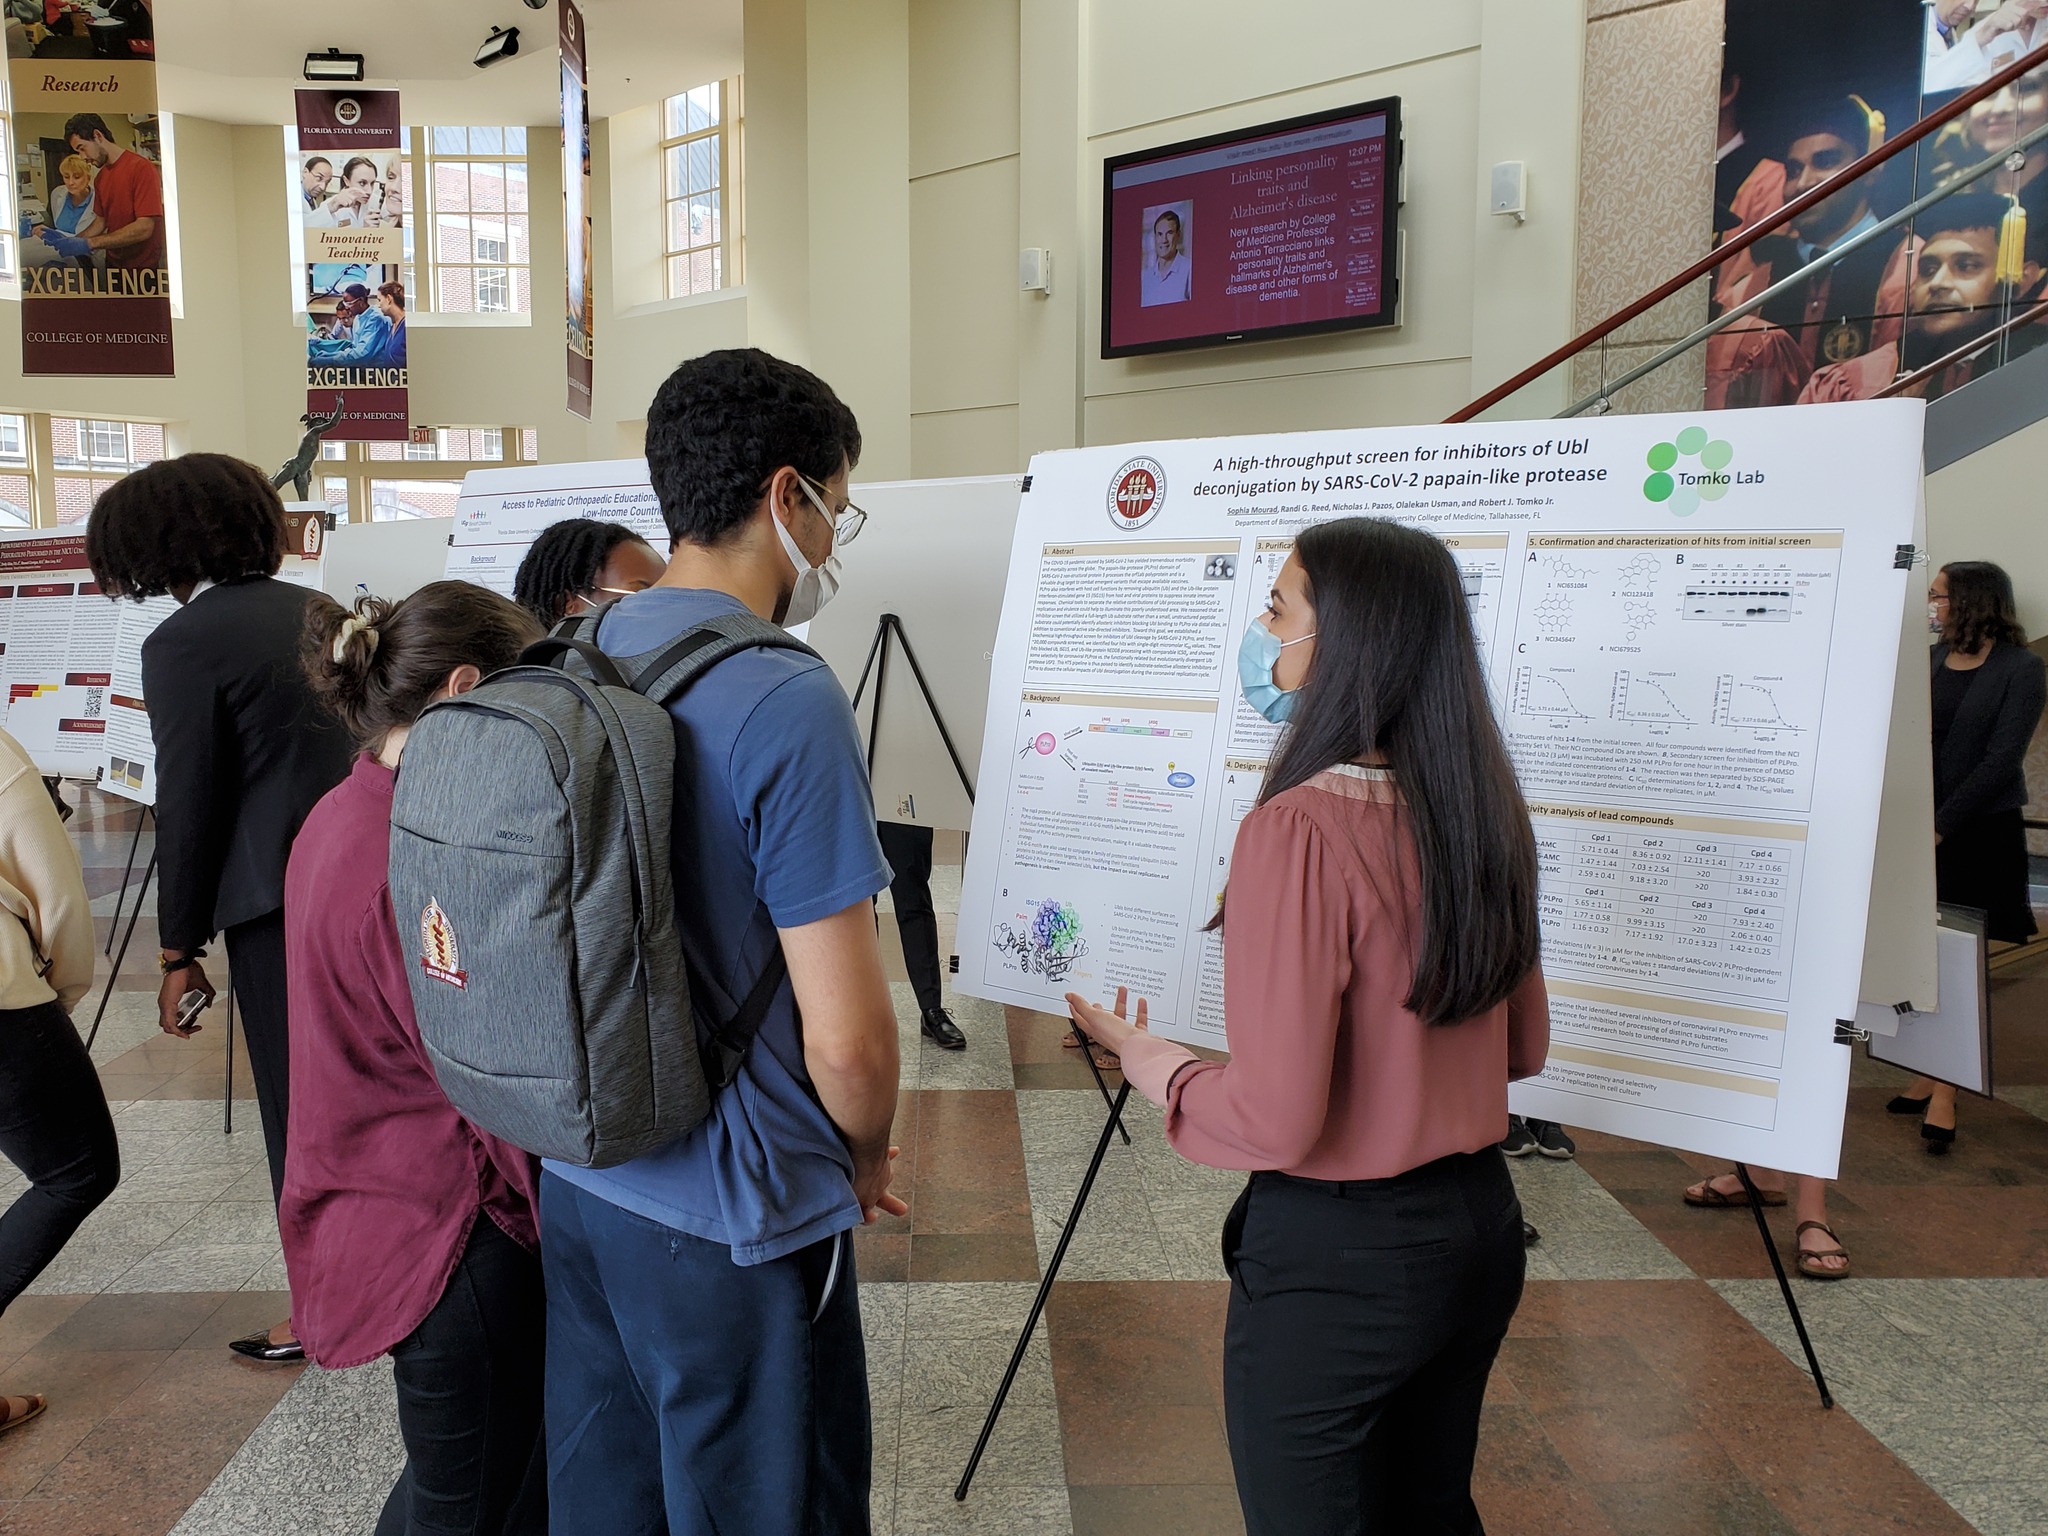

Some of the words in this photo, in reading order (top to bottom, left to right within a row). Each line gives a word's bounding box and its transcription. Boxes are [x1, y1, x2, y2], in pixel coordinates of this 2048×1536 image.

[41, 75, 119, 92] Research
[1349, 146, 1367, 157] 12:07
[1369, 144, 1381, 153] PM
[1231, 168, 1272, 185] Linking
[1276, 154, 1338, 180] personality
[1257, 183, 1284, 197] traits
[1288, 176, 1309, 191] and
[1231, 196, 1294, 219] Alzheimer's
[1298, 192, 1337, 208] disease
[1230, 227, 1248, 238] New
[1251, 220, 1287, 235] research
[1290, 218, 1300, 229] by
[1302, 213, 1336, 225] College
[320, 232, 384, 244] Innovative
[1236, 238, 1245, 248] of
[1247, 233, 1284, 246] Medicine
[1287, 225, 1328, 240] Professor
[1230, 249, 1261, 260] Antonio
[1264, 241, 1312, 254] Terracciano
[1315, 236, 1335, 247] links
[328, 247, 380, 262] Teaching
[1238, 256, 1283, 272] personality
[1286, 253, 1306, 263] traits
[1309, 248, 1325, 259] and
[1231, 270, 1270, 283] hallmarks
[1273, 266, 1281, 277] of
[1282, 259, 1333, 275] Alzheimer's
[1226, 283, 1257, 295] disease
[1260, 279, 1275, 290] and
[1278, 276, 1300, 288] other
[1302, 273, 1326, 284] forms
[1329, 269, 1339, 279] of
[1259, 288, 1300, 301] dementia.
[27, 332, 83, 343] COLLEGE
[86, 333, 102, 343] OF
[105, 333, 168, 344] MEDICINE
[307, 367, 407, 387] EXCELLENCE
[310, 412, 348, 420] COLLE
[414, 430, 430, 442] EXIT
[1213, 458, 1223, 471] A
[1228, 452, 1352, 473] high-throughput
[1356, 451, 1409, 464] screen
[1414, 446, 1439, 462] for
[1444, 443, 1526, 460] inhibitors
[1533, 440, 1552, 456] of
[1557, 438, 1589, 455] Ubl
[1193, 479, 1296, 497] deconjugation
[1301, 477, 1320, 494] by
[1324, 473, 1419, 491] SARS-CoV-2
[1423, 468, 1520, 490] papain-like
[1526, 467, 1607, 486] protease
[1679, 471, 1731, 487] Tomko
[1737, 469, 1765, 485] Lab
[1110, 474, 1123, 515] FLORIDA
[1123, 461, 1145, 474] STATE
[1147, 462, 1163, 513] UNIVERSITY
[502, 499, 526, 510] Access
[528, 498, 534, 508] to
[536, 496, 565, 508] Pediatric
[568, 494, 612, 506] Orthopaedic
[1227, 507, 1250, 515] Sophia
[1251, 506, 1279, 514] Mourad,
[1311, 504, 1331, 513] Reed,
[1332, 503, 1363, 511] Nicholas
[1372, 502, 1394, 511] Pazos,
[1396, 501, 1429, 510] Olalekan
[1431, 500, 1460, 508] Usman,
[1462, 499, 1476, 507] and
[1479, 498, 1506, 507] Robert
[1508, 498, 1514, 506] J.
[1516, 498, 1543, 506] Tomko
[1545, 497, 1554, 505] Jr.
[582, 508, 628, 519] Low-Income
[630, 506, 663, 516] Countri
[1418, 513, 1444, 522] College
[1444, 513, 1451, 521] of
[1453, 513, 1486, 521] Medicine,
[1489, 512, 1531, 520] Tallahassee,
[1124, 519, 1139, 527] 1851
[1235, 519, 1270, 528] Department
[1279, 517, 1312, 525] Biomedical
[1265, 541, 1294, 549] Purificat
[1539, 538, 1595, 546] Confirmation
[1691, 536, 1701, 545] of
[1703, 537, 1720, 545] hits
[1723, 537, 1746, 545] from
[1750, 536, 1776, 545] initial
[471, 555, 496, 563] Background
[1255, 555, 1262, 564] A
[1528, 552, 1536, 562] A
[1676, 554, 1684, 564] B
[1518, 643, 1526, 653] C
[1029, 694, 1060, 702] Background
[1025, 709, 1031, 717] A
[1234, 761, 1258, 770] Design
[1228, 775, 1235, 784] A
[1527, 805, 1548, 816] tivity
[1550, 808, 1585, 818] analysis
[1587, 810, 1596, 819] of
[1599, 810, 1619, 821] lead
[1620, 814, 1674, 826] compounds
[1592, 834, 1604, 843] Cpd
[1643, 839, 1656, 848] Cpd
[1696, 844, 1710, 854] Cpd
[1751, 849, 1764, 858] Cpd
[1768, 850, 1772, 858] 4
[1218, 857, 1224, 865] B
[1003, 889, 1008, 897] B
[1560, 1068, 1585, 1078] improve
[1586, 1072, 1611, 1083] potency
[1612, 1075, 1624, 1084] and
[1626, 1078, 1657, 1092] selectivity
[1566, 1078, 1598, 1088] replication
[1607, 1084, 1618, 1092] cell
[1620, 1086, 1641, 1096] culture
